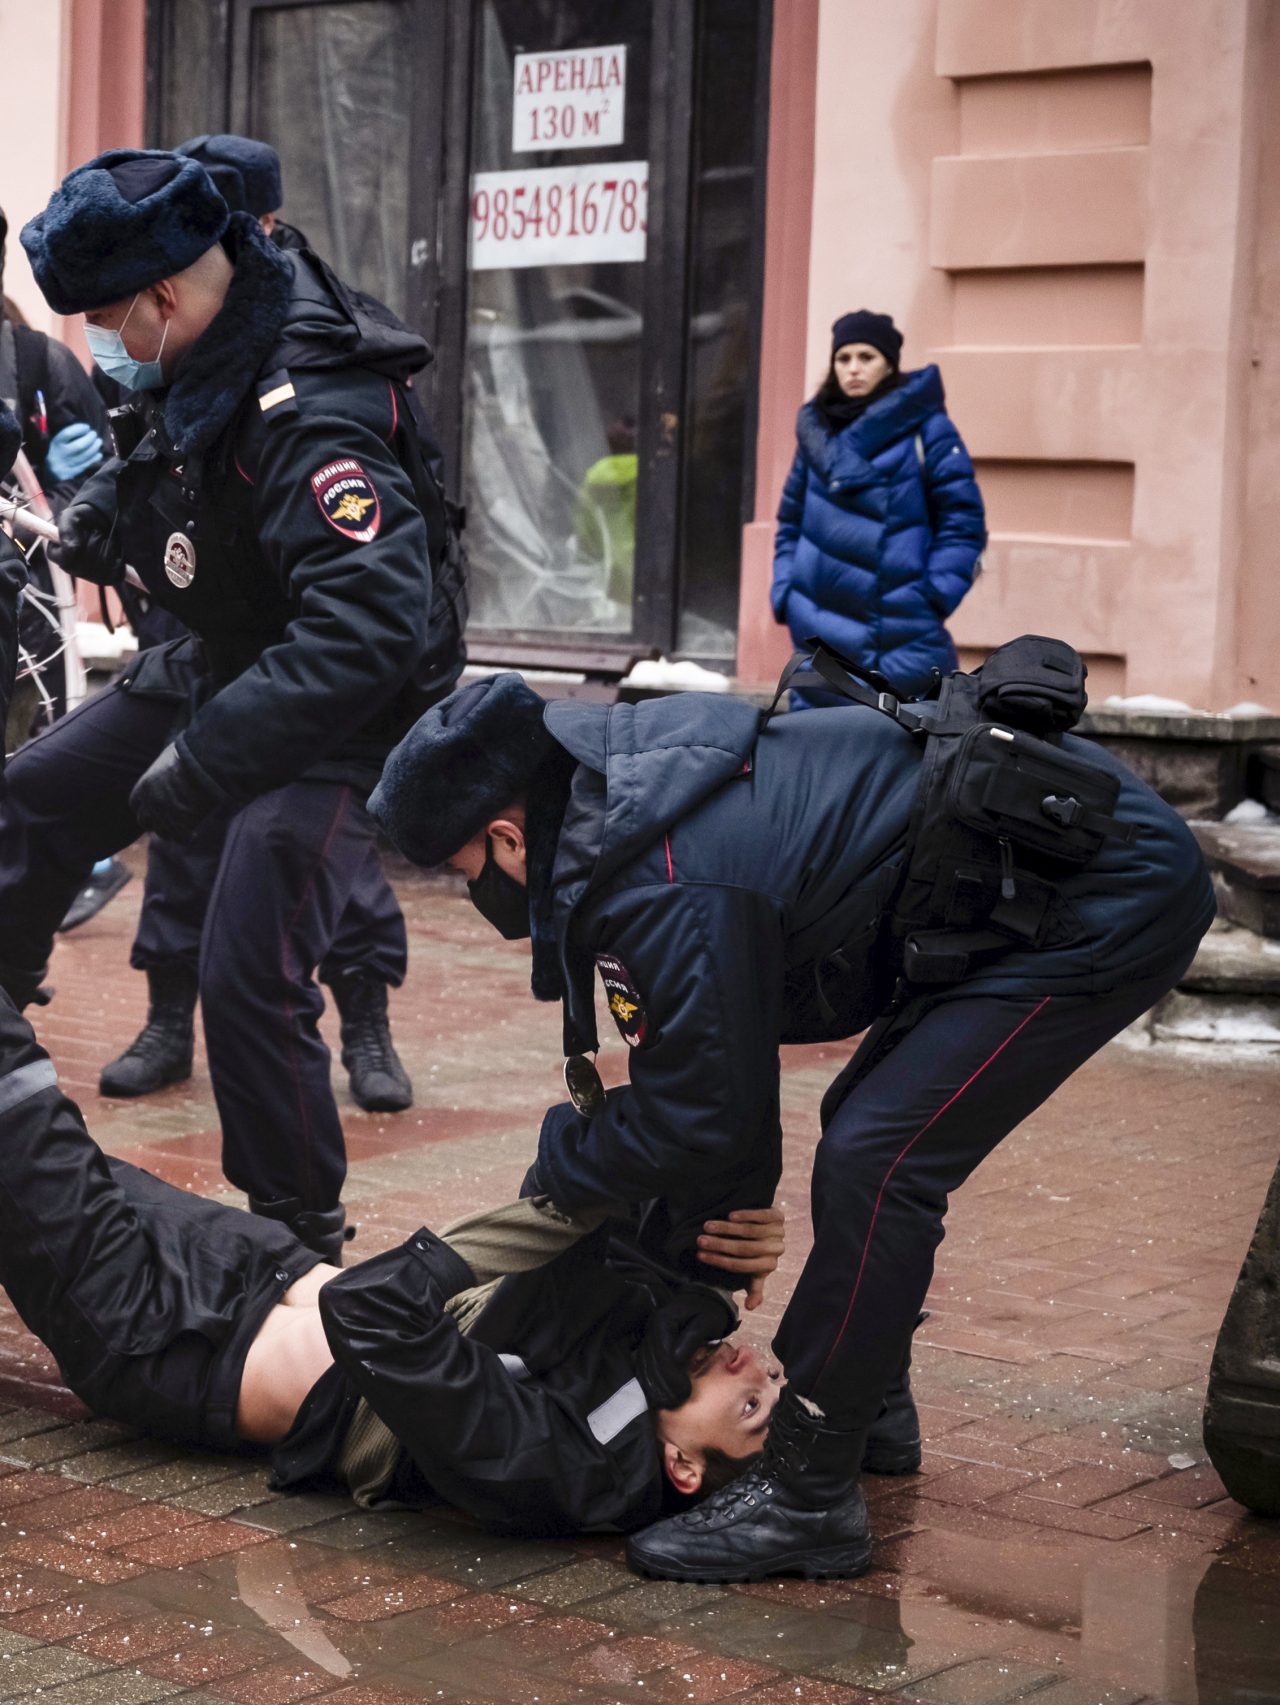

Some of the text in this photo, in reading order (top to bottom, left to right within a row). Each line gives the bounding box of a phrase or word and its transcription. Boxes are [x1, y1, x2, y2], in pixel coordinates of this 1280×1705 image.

[516, 55, 621, 96] АРЕНДА
[529, 105, 575, 141] 130
[313, 461, 358, 488] ПОЛИЦИЯ
[323, 479, 367, 505] РОССИЯ
